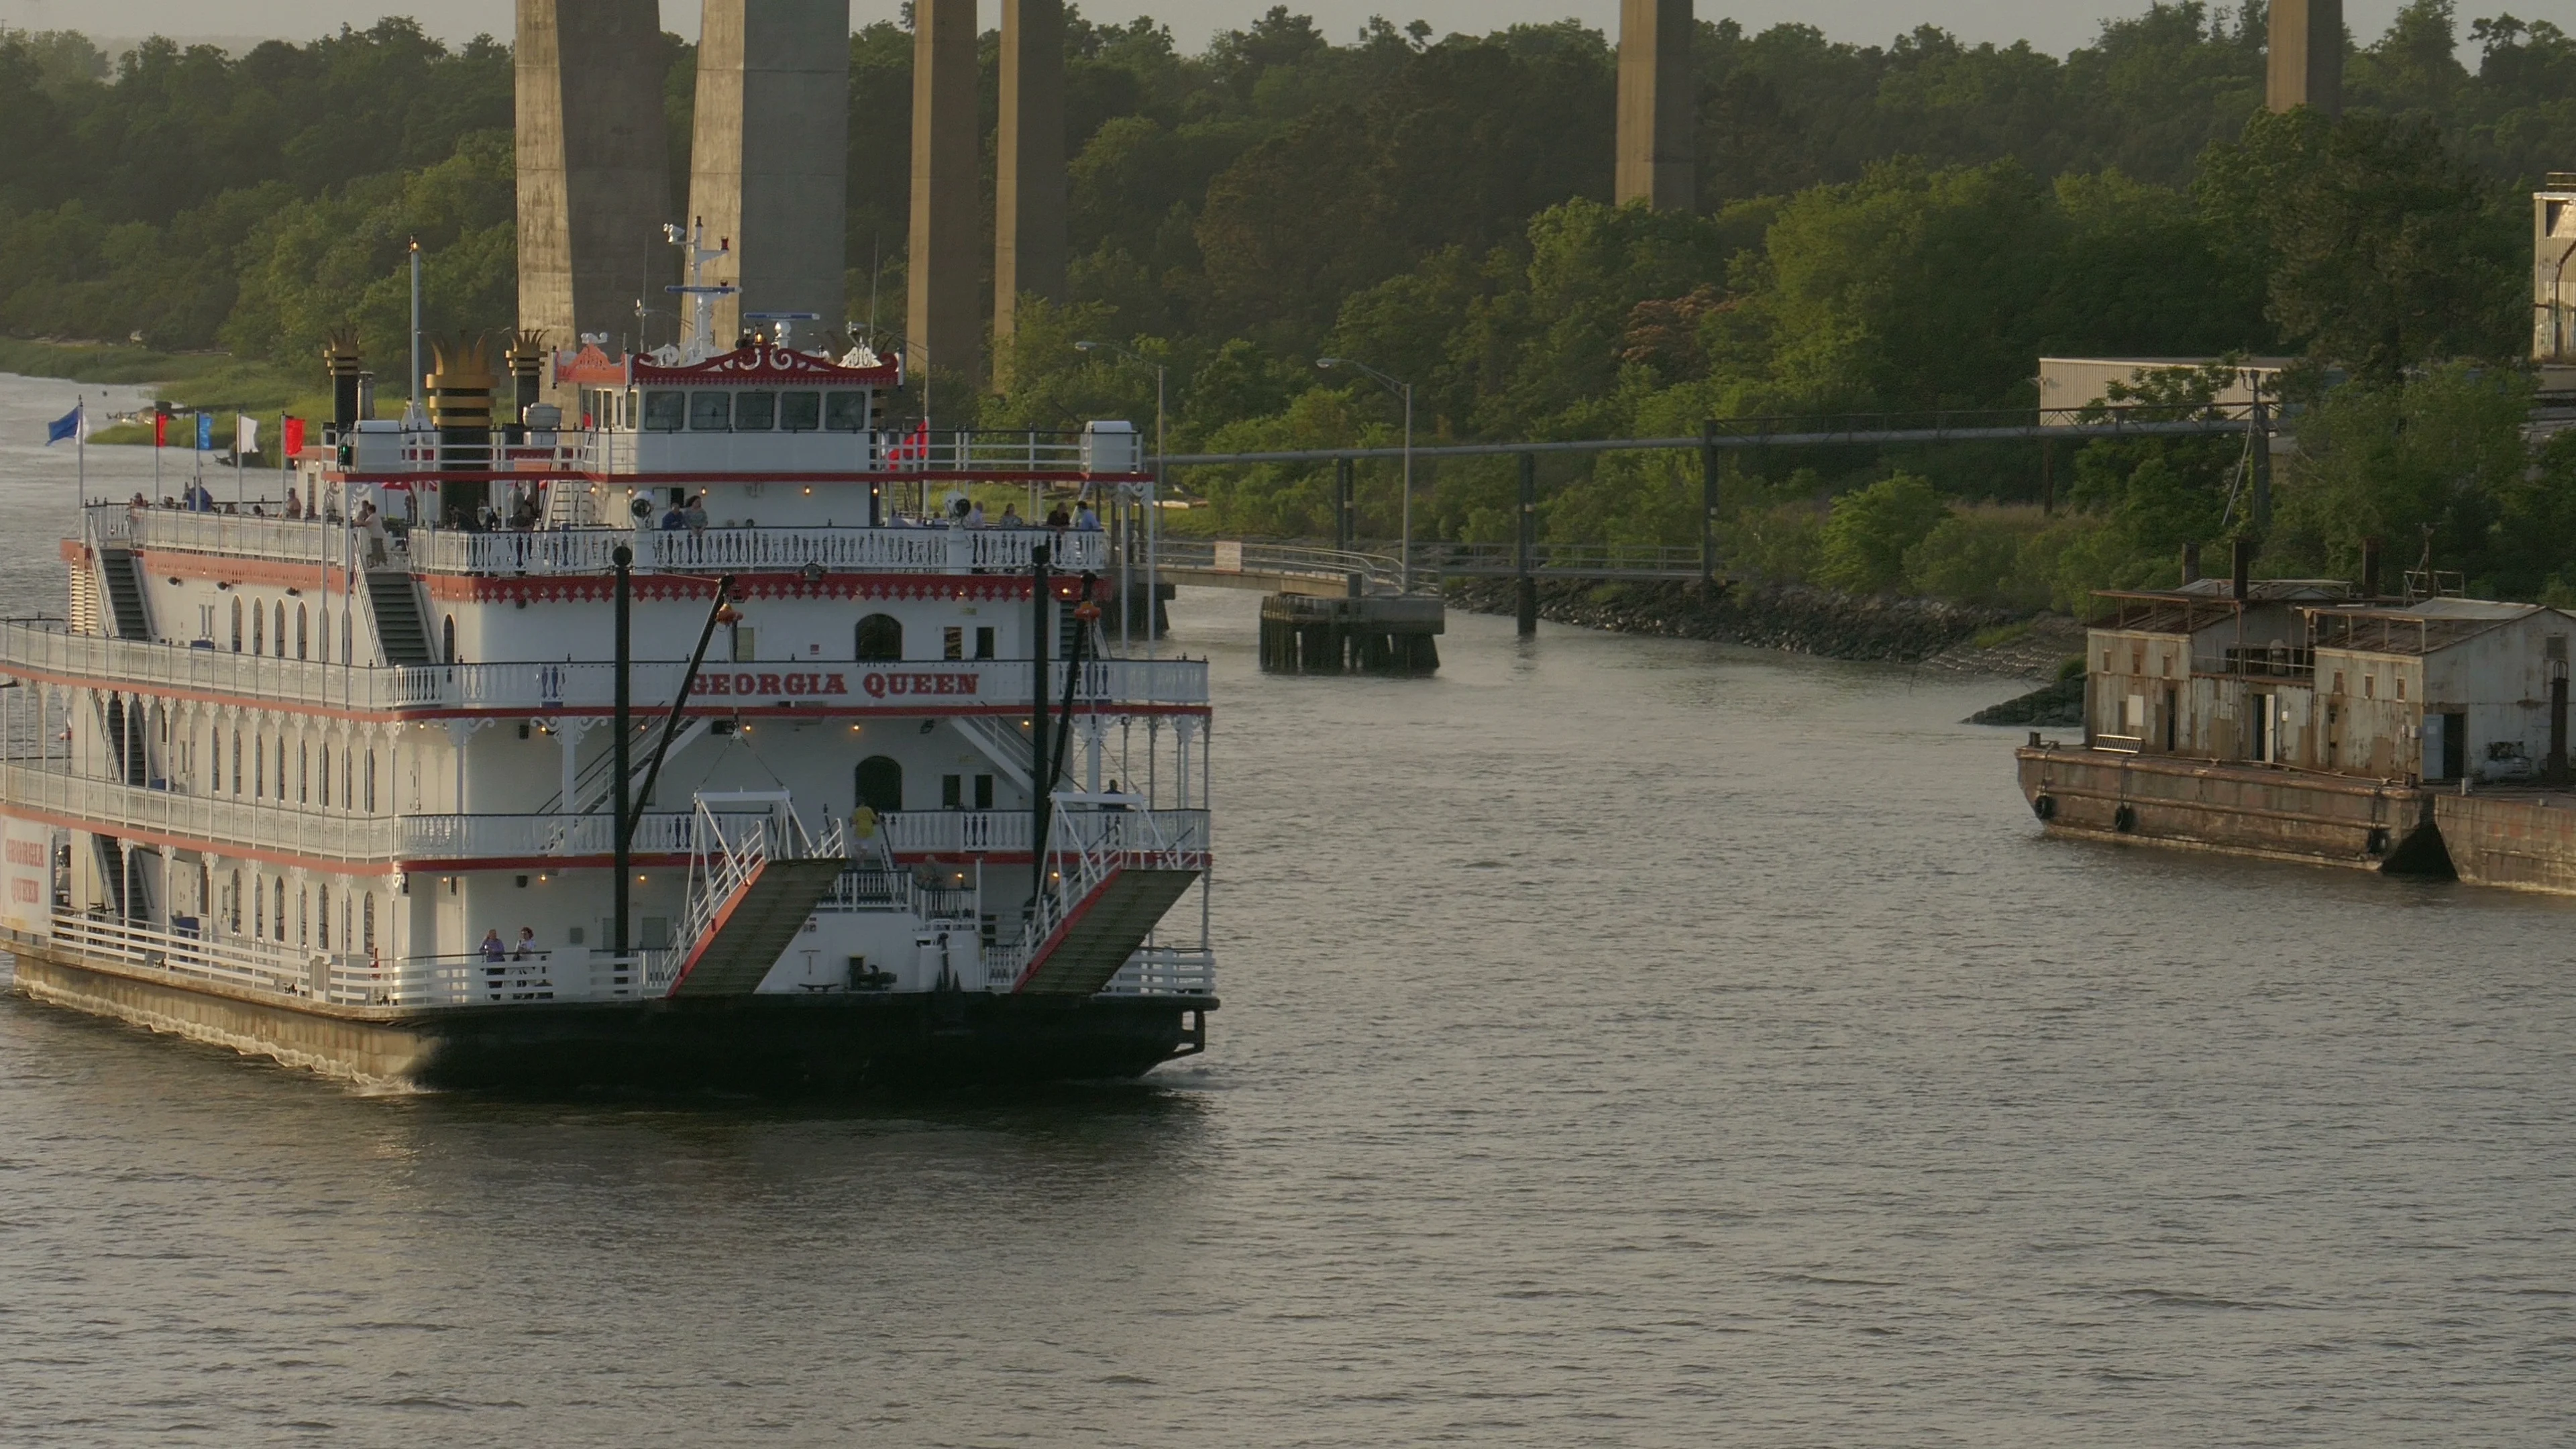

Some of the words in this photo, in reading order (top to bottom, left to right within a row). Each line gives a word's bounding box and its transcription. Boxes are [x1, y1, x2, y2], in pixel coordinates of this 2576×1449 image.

[689, 673, 849, 696] GEORGIA
[863, 672, 979, 699] QUEEN
[5, 838, 44, 868] GEORGIA
[11, 876, 39, 904] QUEEN
